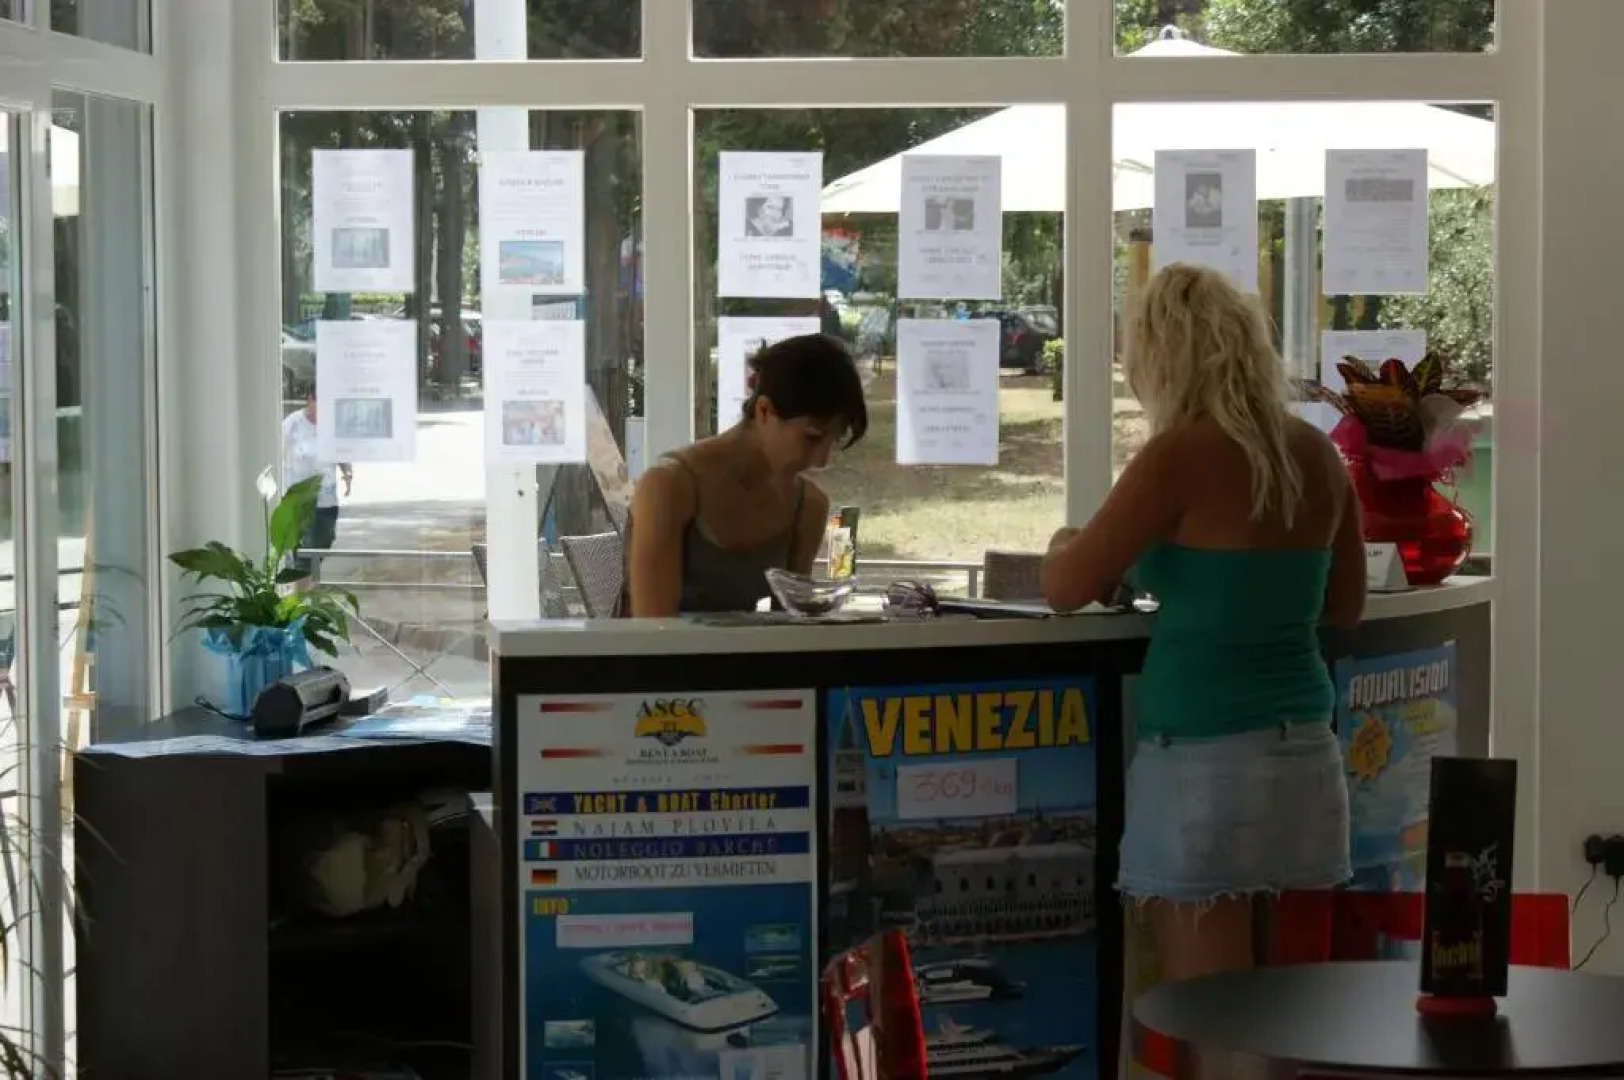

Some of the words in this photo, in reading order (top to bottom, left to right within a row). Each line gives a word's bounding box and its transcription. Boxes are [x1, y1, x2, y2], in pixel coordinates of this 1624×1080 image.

[861, 686, 1091, 757] VENEZIA
[910, 768, 976, 802] 369
[574, 793, 626, 813] YACHT
